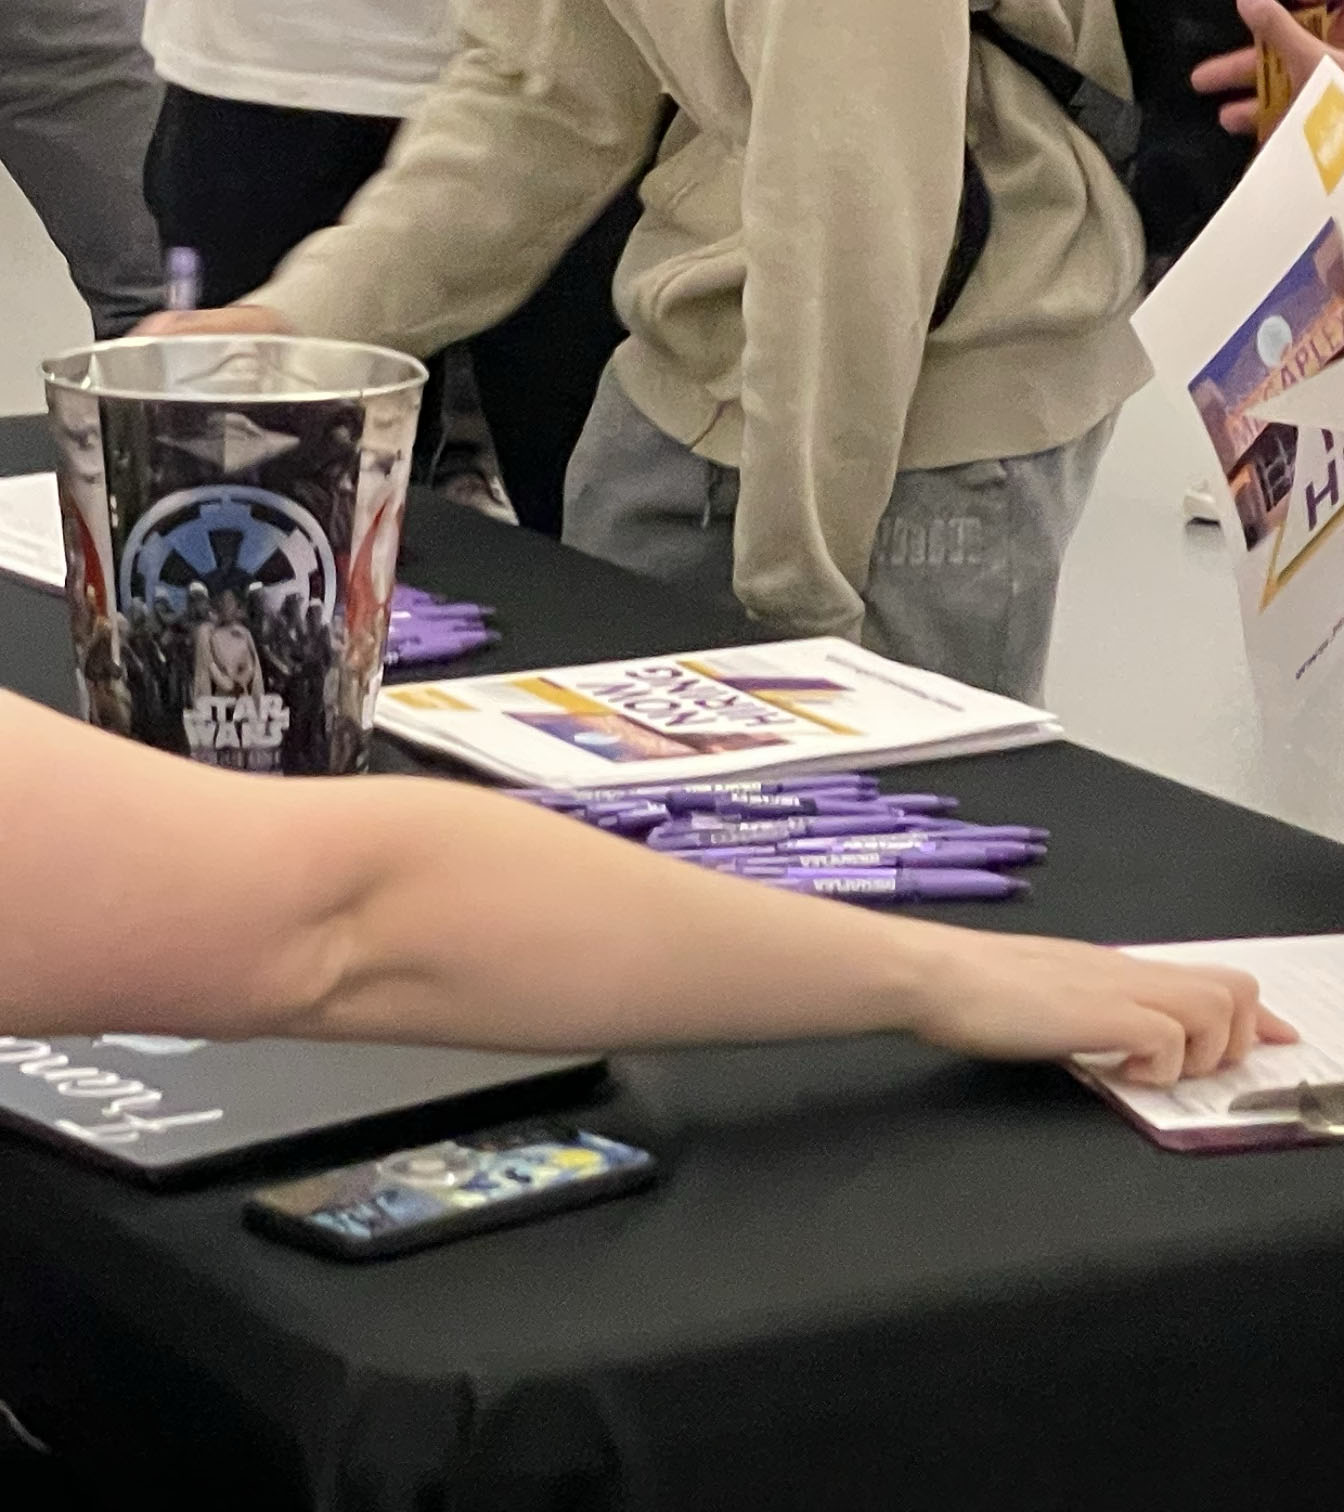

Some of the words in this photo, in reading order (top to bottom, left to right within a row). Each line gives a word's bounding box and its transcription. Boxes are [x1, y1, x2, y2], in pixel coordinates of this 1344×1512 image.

[184, 693, 290, 728] STAR
[575, 682, 718, 727] NOW
[625, 665, 796, 727] HIRING
[184, 717, 288, 750] WARS
